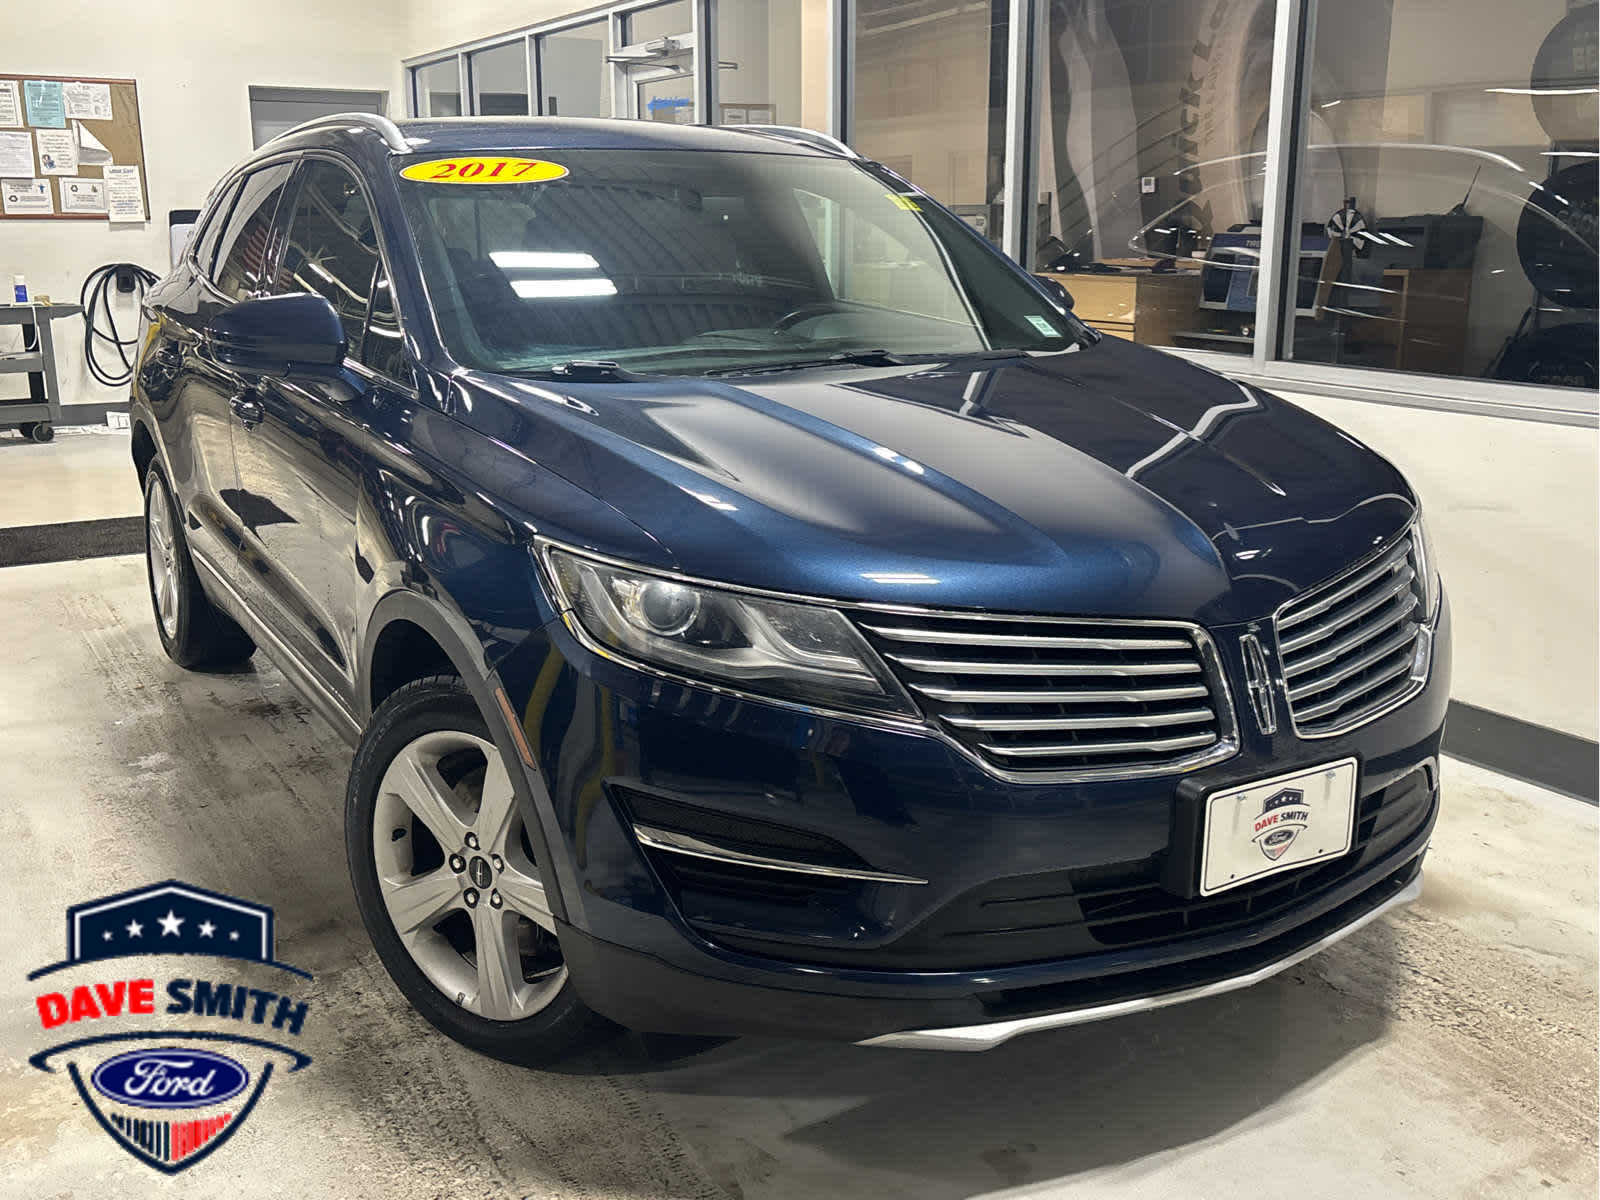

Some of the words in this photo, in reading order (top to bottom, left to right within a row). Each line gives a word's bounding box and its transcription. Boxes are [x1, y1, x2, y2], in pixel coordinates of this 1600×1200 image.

[430, 161, 537, 179] 2017
[1254, 814, 1279, 832] DAVE
[1280, 811, 1309, 821] SMITH
